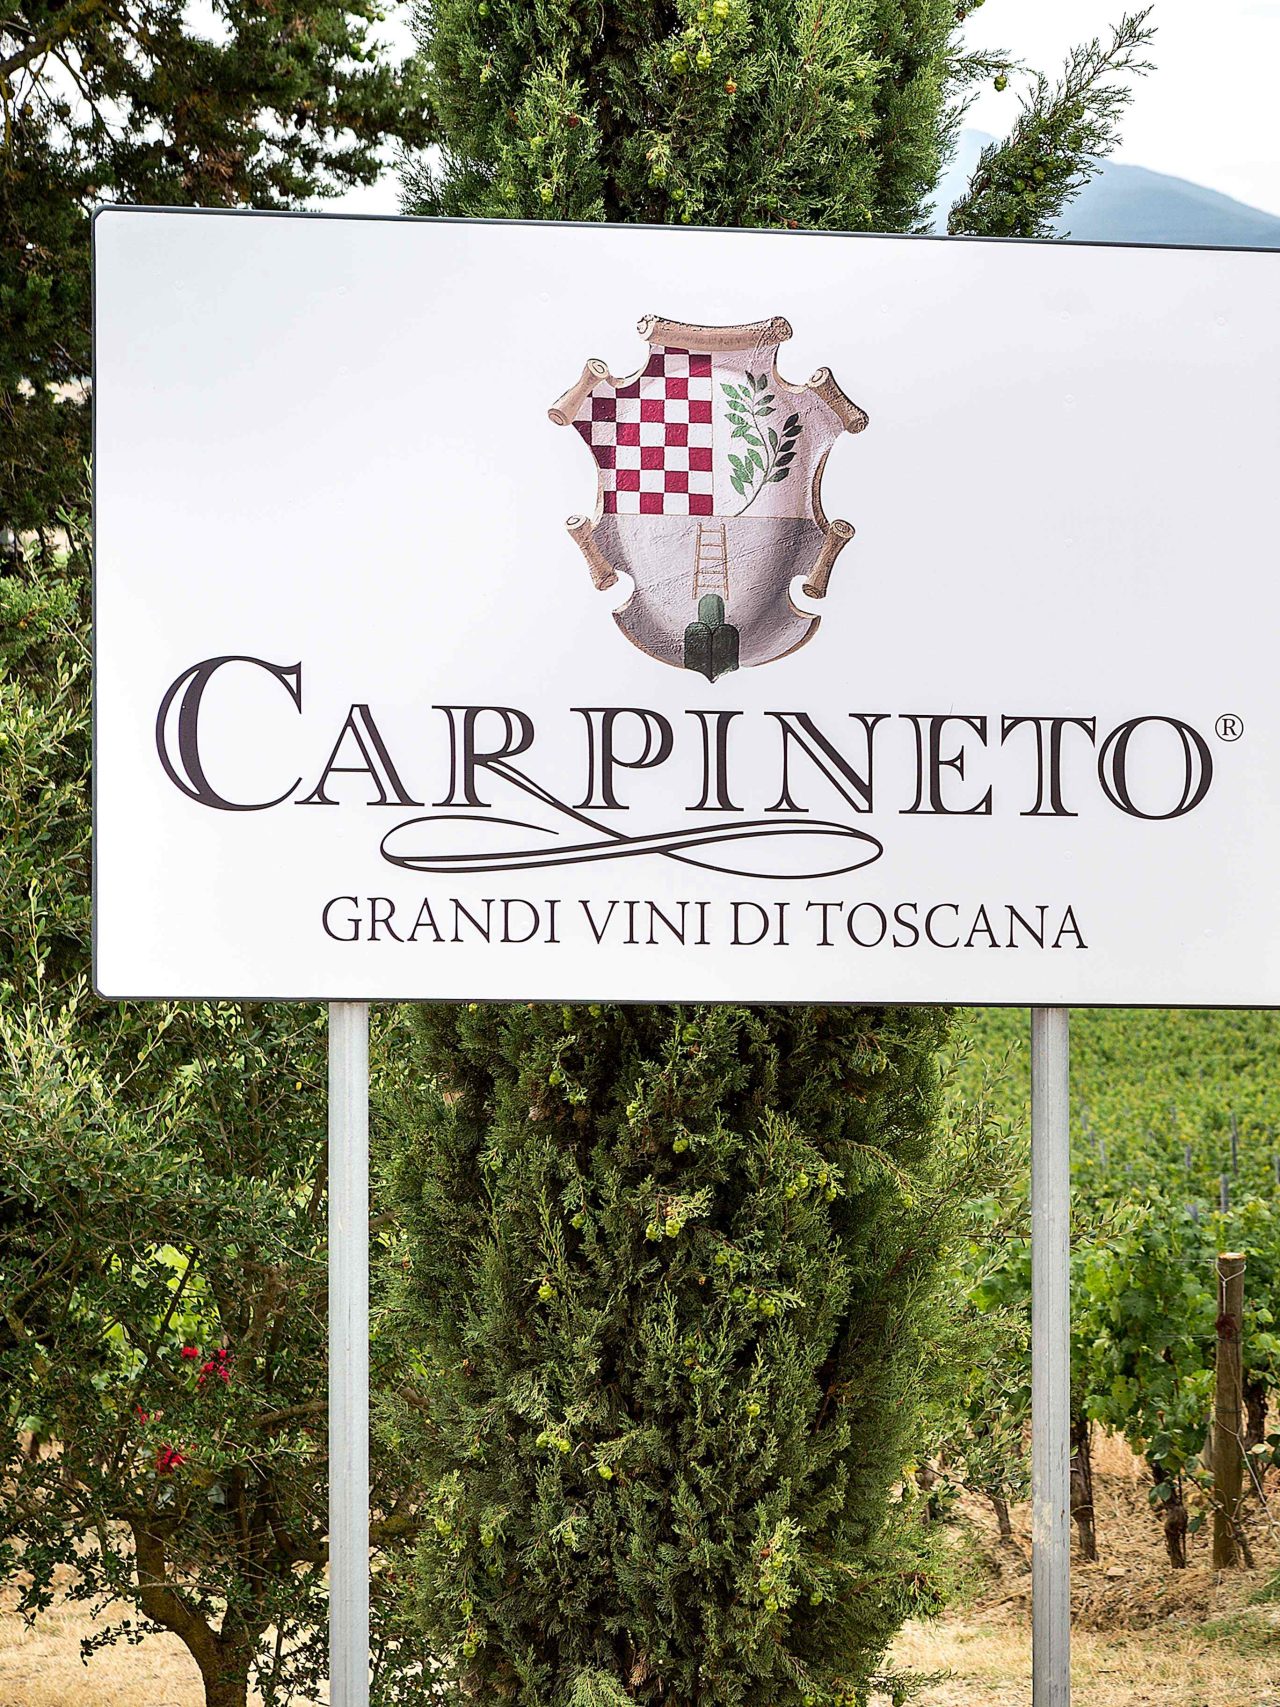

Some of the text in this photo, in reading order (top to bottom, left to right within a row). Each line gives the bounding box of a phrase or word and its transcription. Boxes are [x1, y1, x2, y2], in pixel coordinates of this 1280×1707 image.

[322, 896, 1089, 950] GRANDI VINI DI TOSCANA
